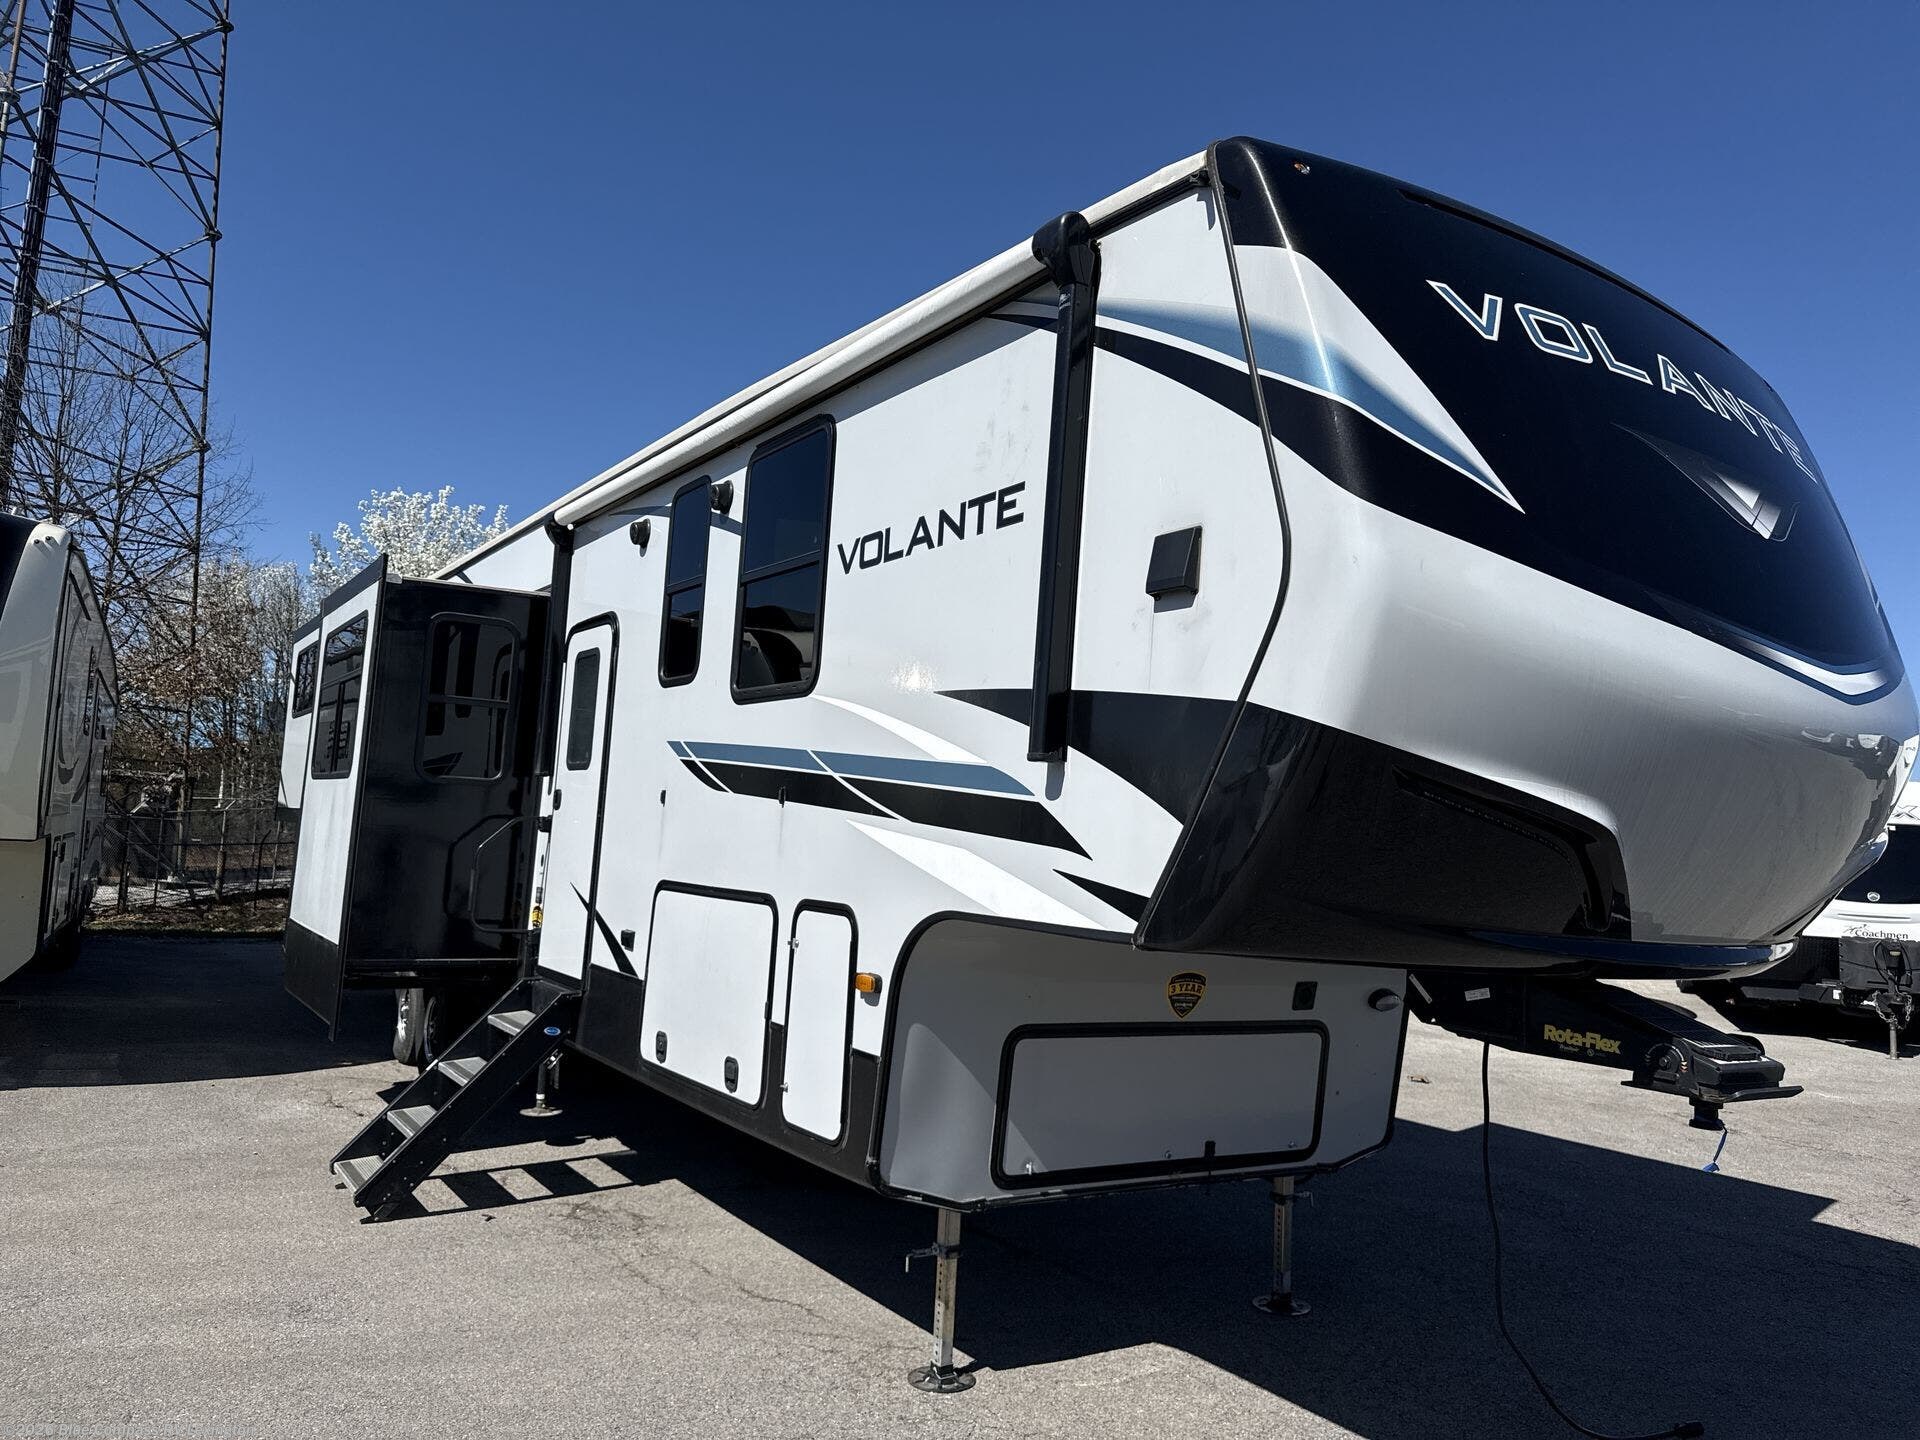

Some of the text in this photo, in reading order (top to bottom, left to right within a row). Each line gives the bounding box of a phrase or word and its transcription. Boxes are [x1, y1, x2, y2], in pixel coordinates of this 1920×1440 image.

[1426, 279, 1818, 484] VOLANTE
[837, 481, 1026, 575] VOLANTE
[1854, 930, 1909, 940] Coachmen
[1170, 983, 1203, 994] 3 YEAR
[1543, 1023, 1622, 1055] Rota-Flex
